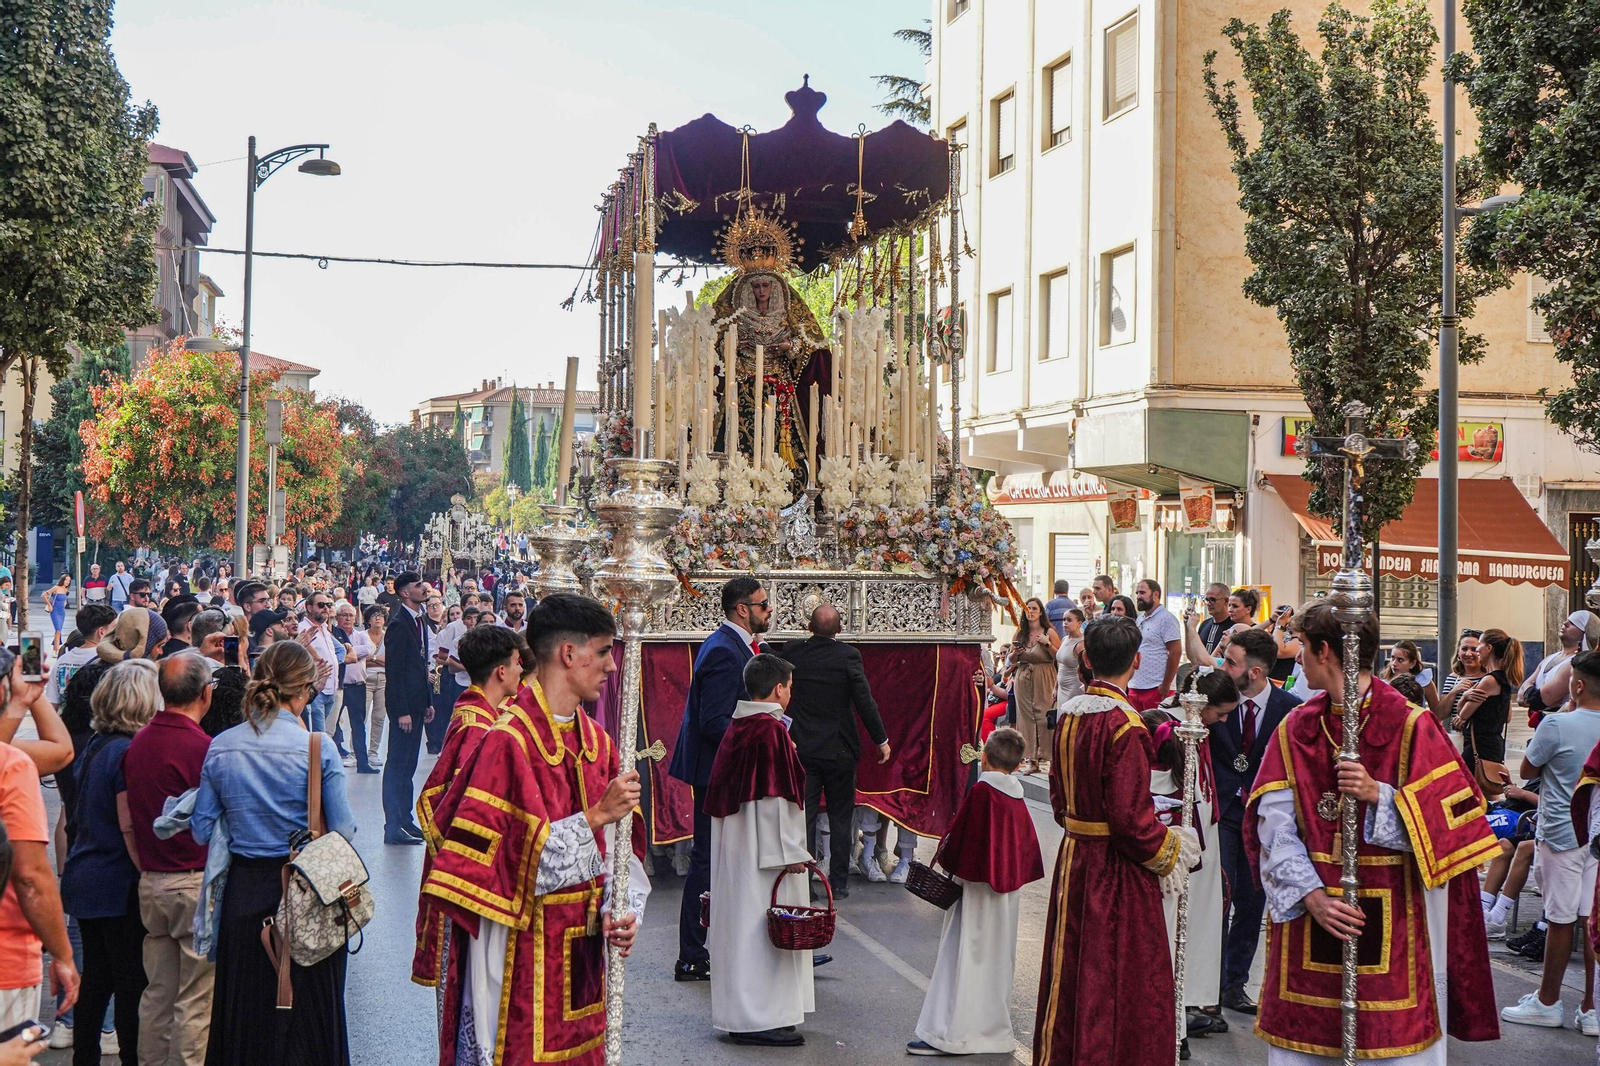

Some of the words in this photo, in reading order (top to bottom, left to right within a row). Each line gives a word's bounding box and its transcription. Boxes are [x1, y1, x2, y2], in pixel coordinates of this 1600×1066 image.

[1366, 555, 1411, 571] BNDEJA
[1420, 558, 1480, 577] SHARMA
[1489, 562, 1564, 582] HAMBURGUESA
